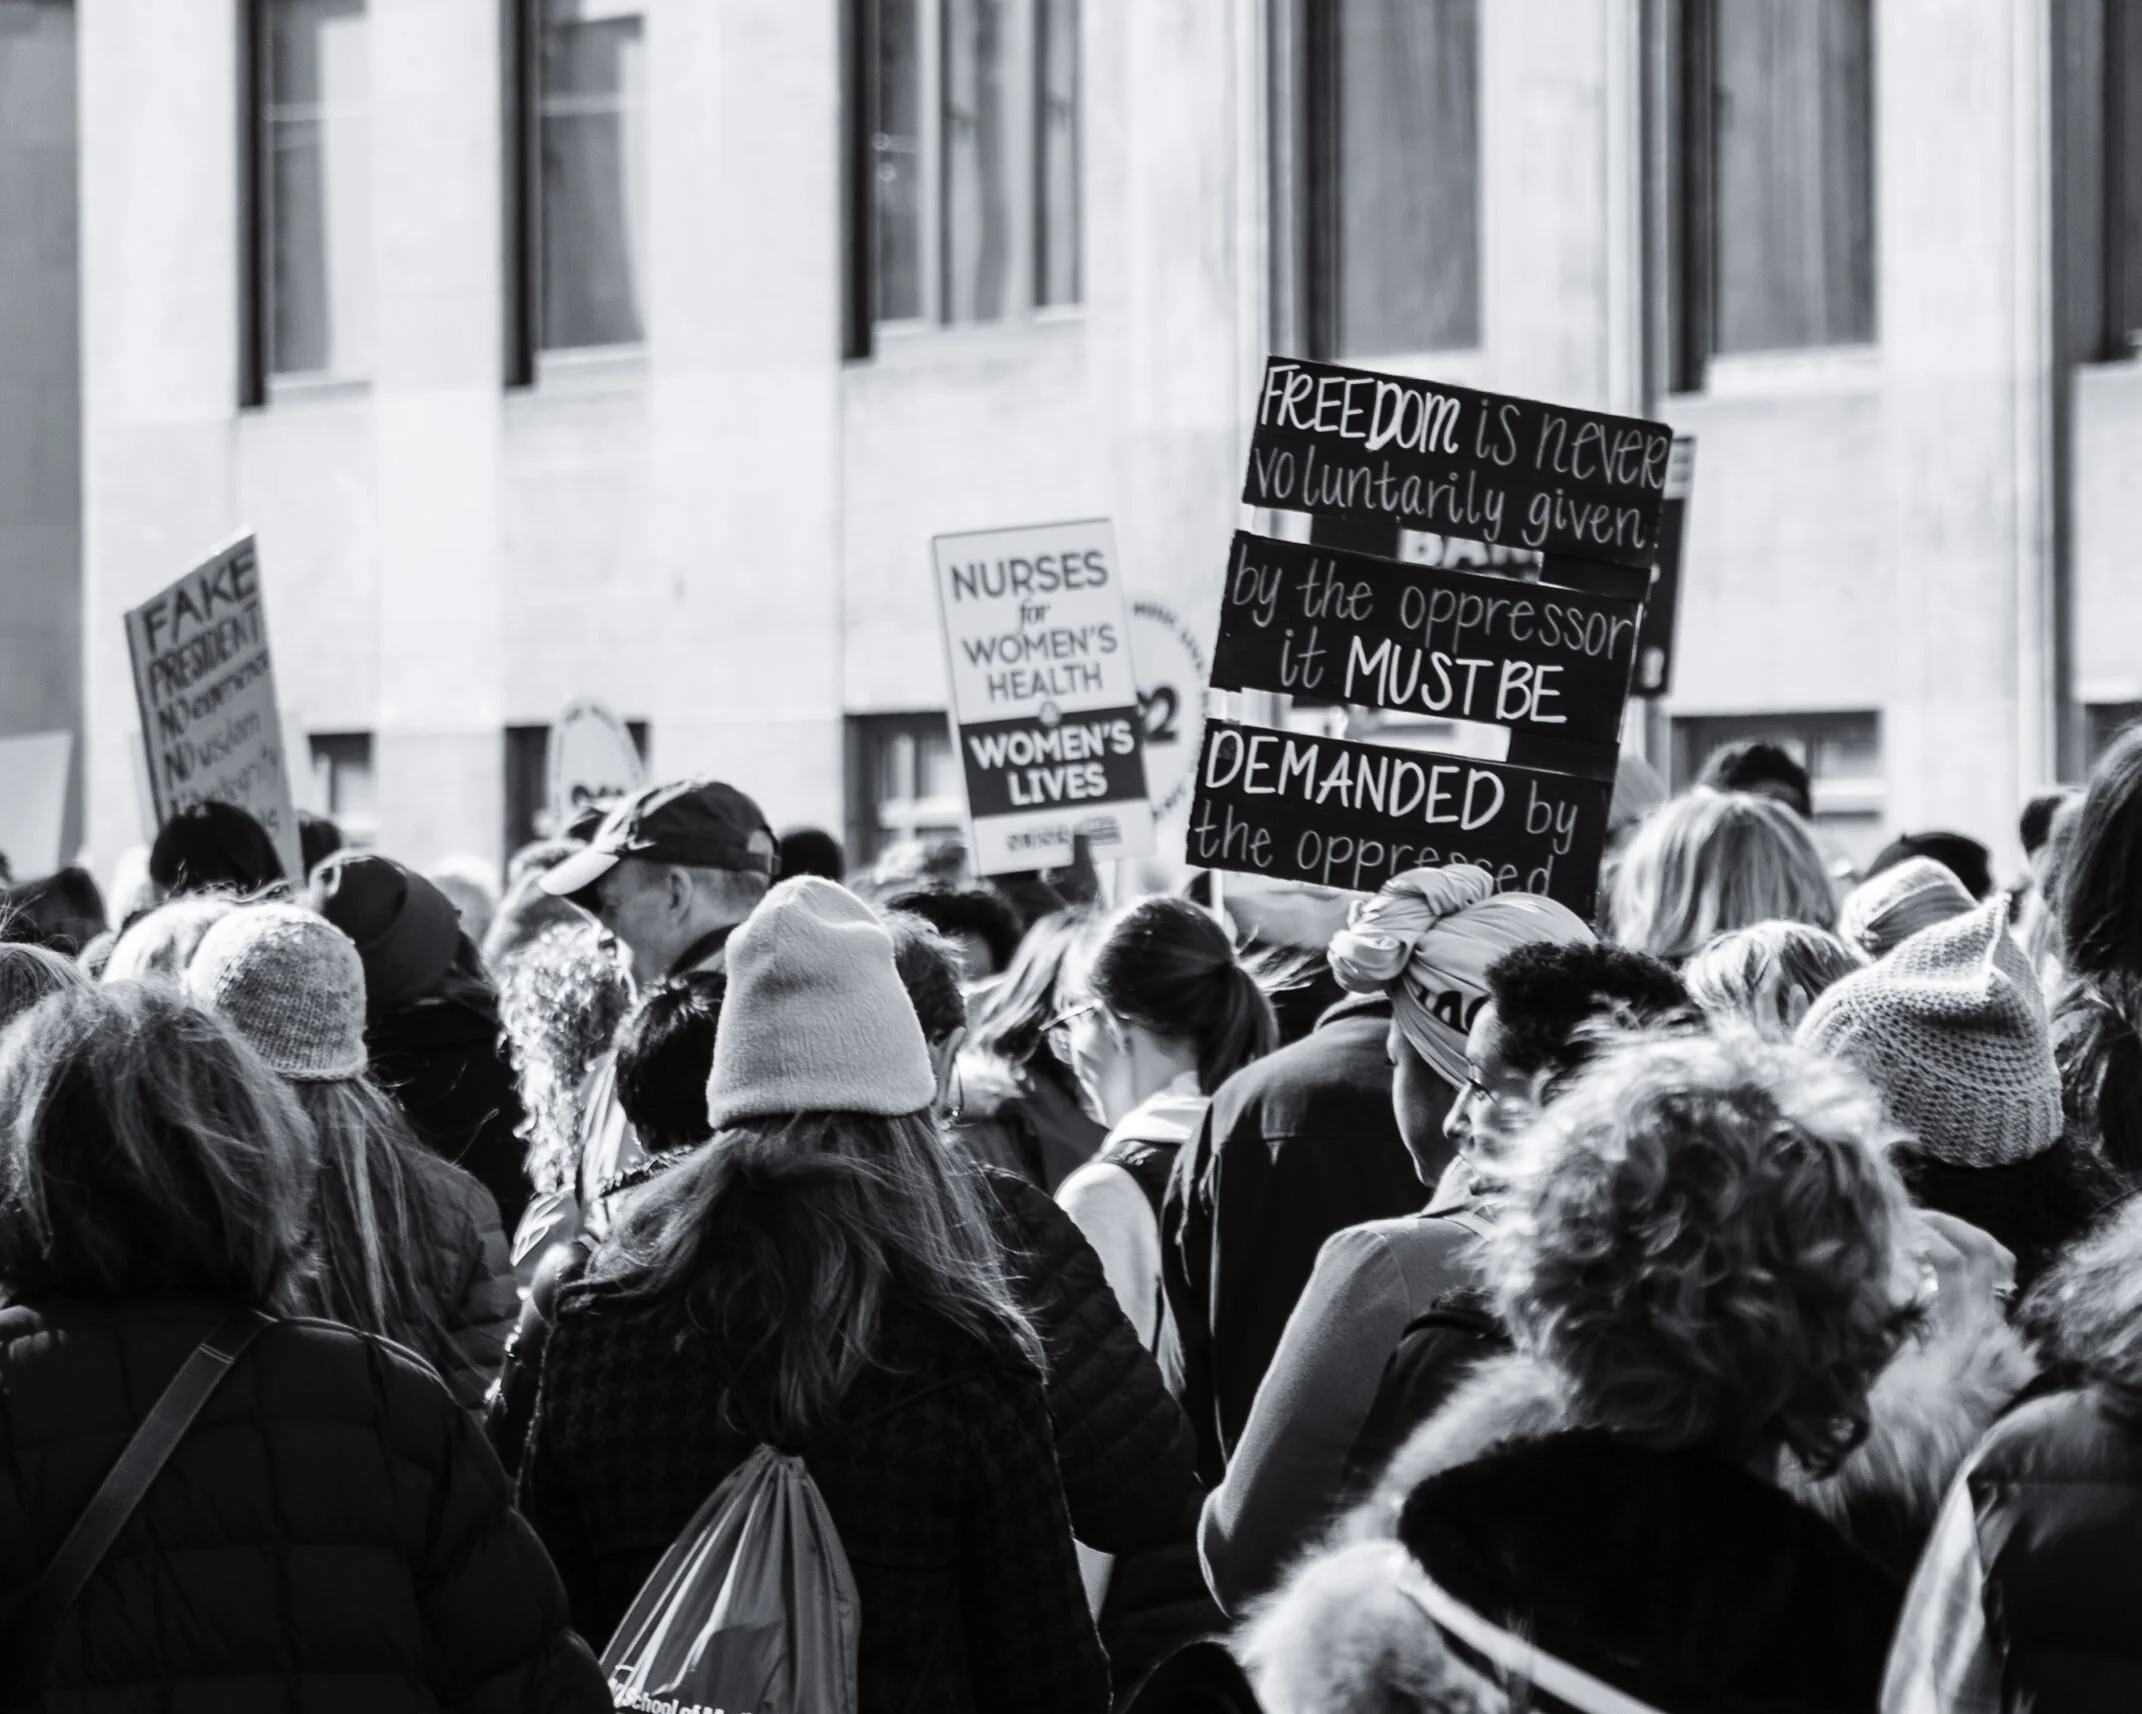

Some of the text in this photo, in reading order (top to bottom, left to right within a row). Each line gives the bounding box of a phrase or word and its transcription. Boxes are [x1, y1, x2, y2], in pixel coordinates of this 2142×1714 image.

[1261, 365, 1461, 453] FREEDOM
[1474, 399, 1522, 466] is
[1254, 445, 1506, 542] voluntarily
[141, 550, 258, 653] FAKE
[950, 549, 1110, 603] NURSES
[1231, 550, 1635, 661] by the oppressor
[147, 601, 265, 707] PRESIDENT
[961, 623, 1119, 668] WOMEN'S
[1018, 600, 1053, 634] for
[986, 661, 1104, 703] HEALTH
[1279, 628, 1328, 690] it
[1344, 634, 1493, 716] MUST
[1496, 659, 1568, 724] BE
[967, 719, 1136, 770] WOMEN'S
[1006, 762, 1109, 807] LIVES
[1193, 800, 1274, 867] the
[1205, 730, 1505, 831] DEMANDED
[1526, 781, 1579, 856] by
